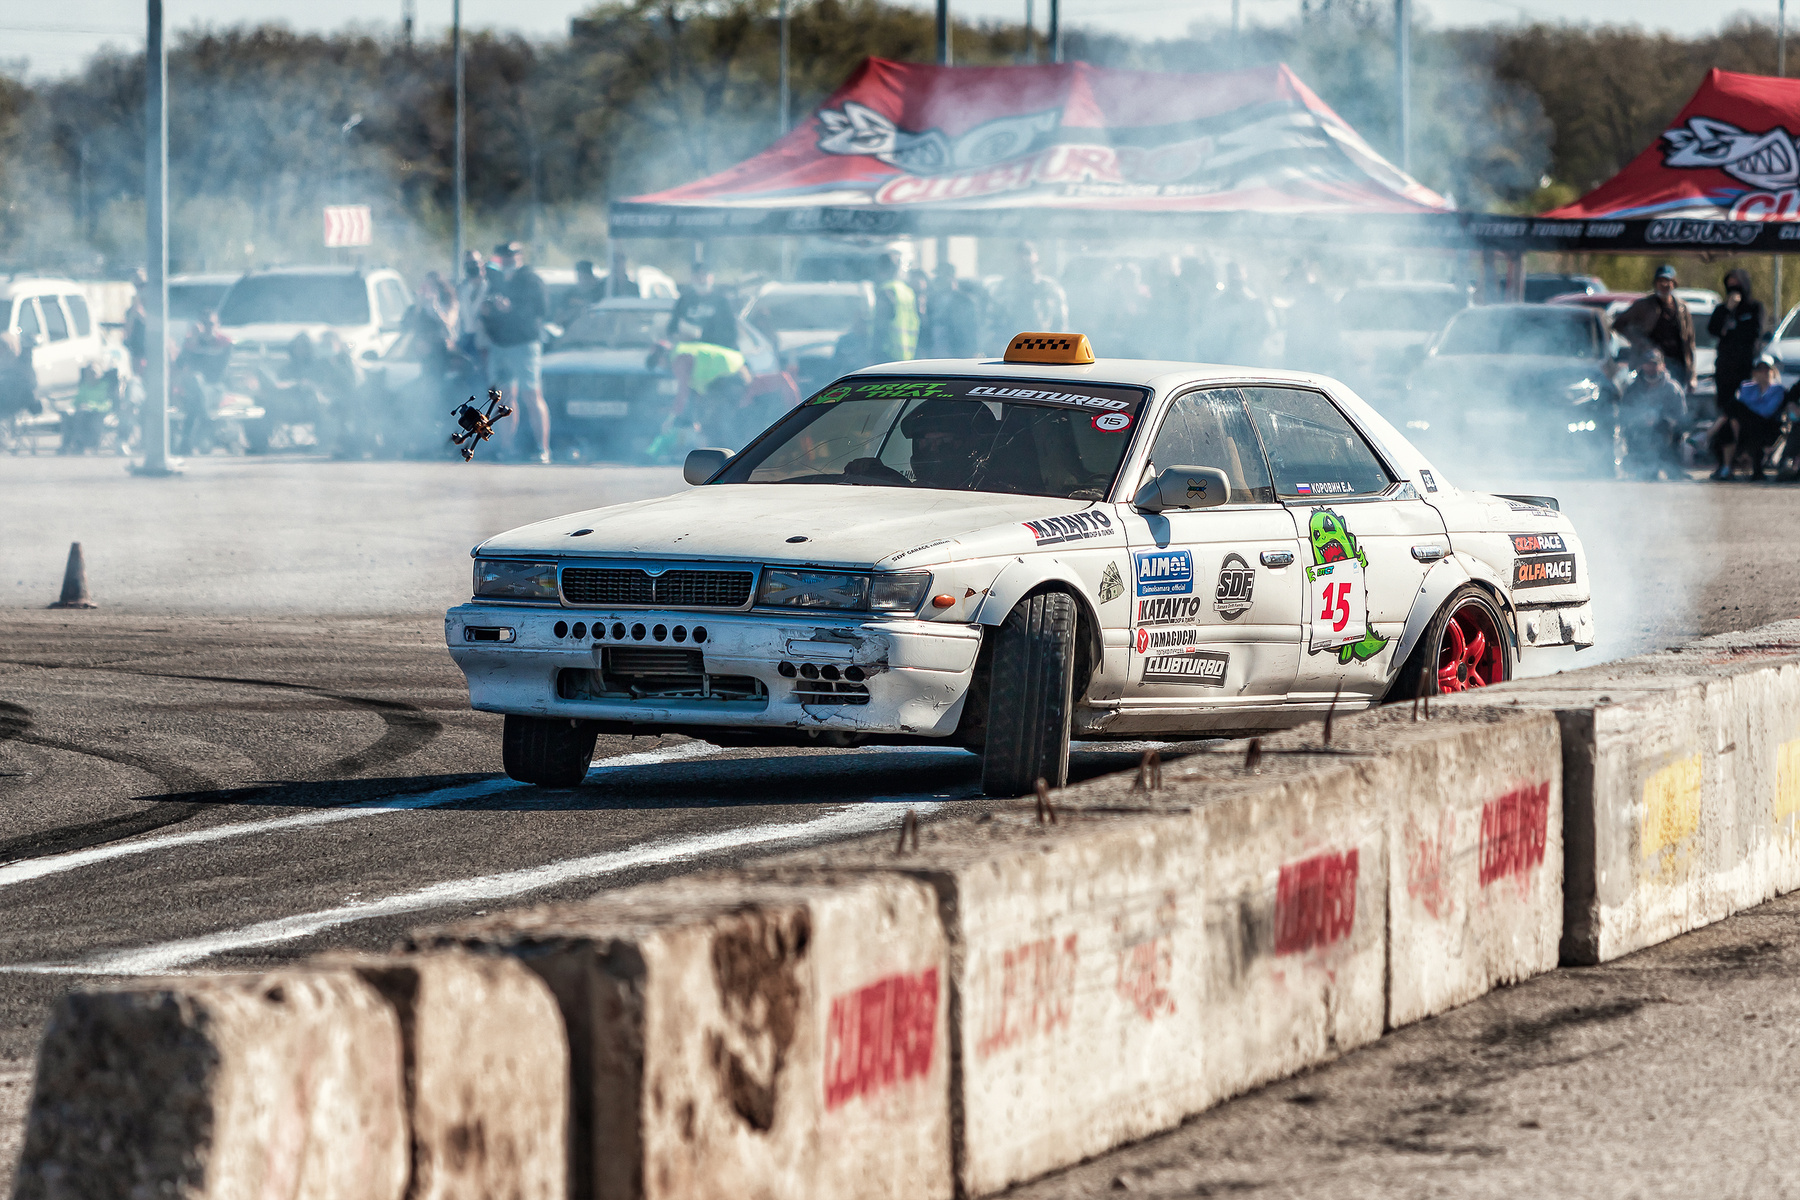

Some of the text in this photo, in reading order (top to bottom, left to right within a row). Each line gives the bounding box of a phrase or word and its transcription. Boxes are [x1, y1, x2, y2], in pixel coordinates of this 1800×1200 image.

[1728, 188, 1800, 222] CL
[1532, 222, 1584, 236] TUNING
[1585, 223, 1626, 237] SHOP
[855, 383, 947, 392] DRIFT
[966, 386, 1130, 411] CLUBTURBO
[1102, 416, 1121, 426] 15
[1311, 482, 1341, 494] КОРОВИН
[1025, 510, 1111, 539] KATAVTO
[1140, 556, 1189, 577] AIMOL
[1217, 571, 1253, 598] SDF
[1139, 597, 1200, 622] KATAVTO
[1321, 582, 1352, 632] 15
[1150, 629, 1197, 648] YAMAGUCHI
[1146, 657, 1226, 678] CLUBTURBO
